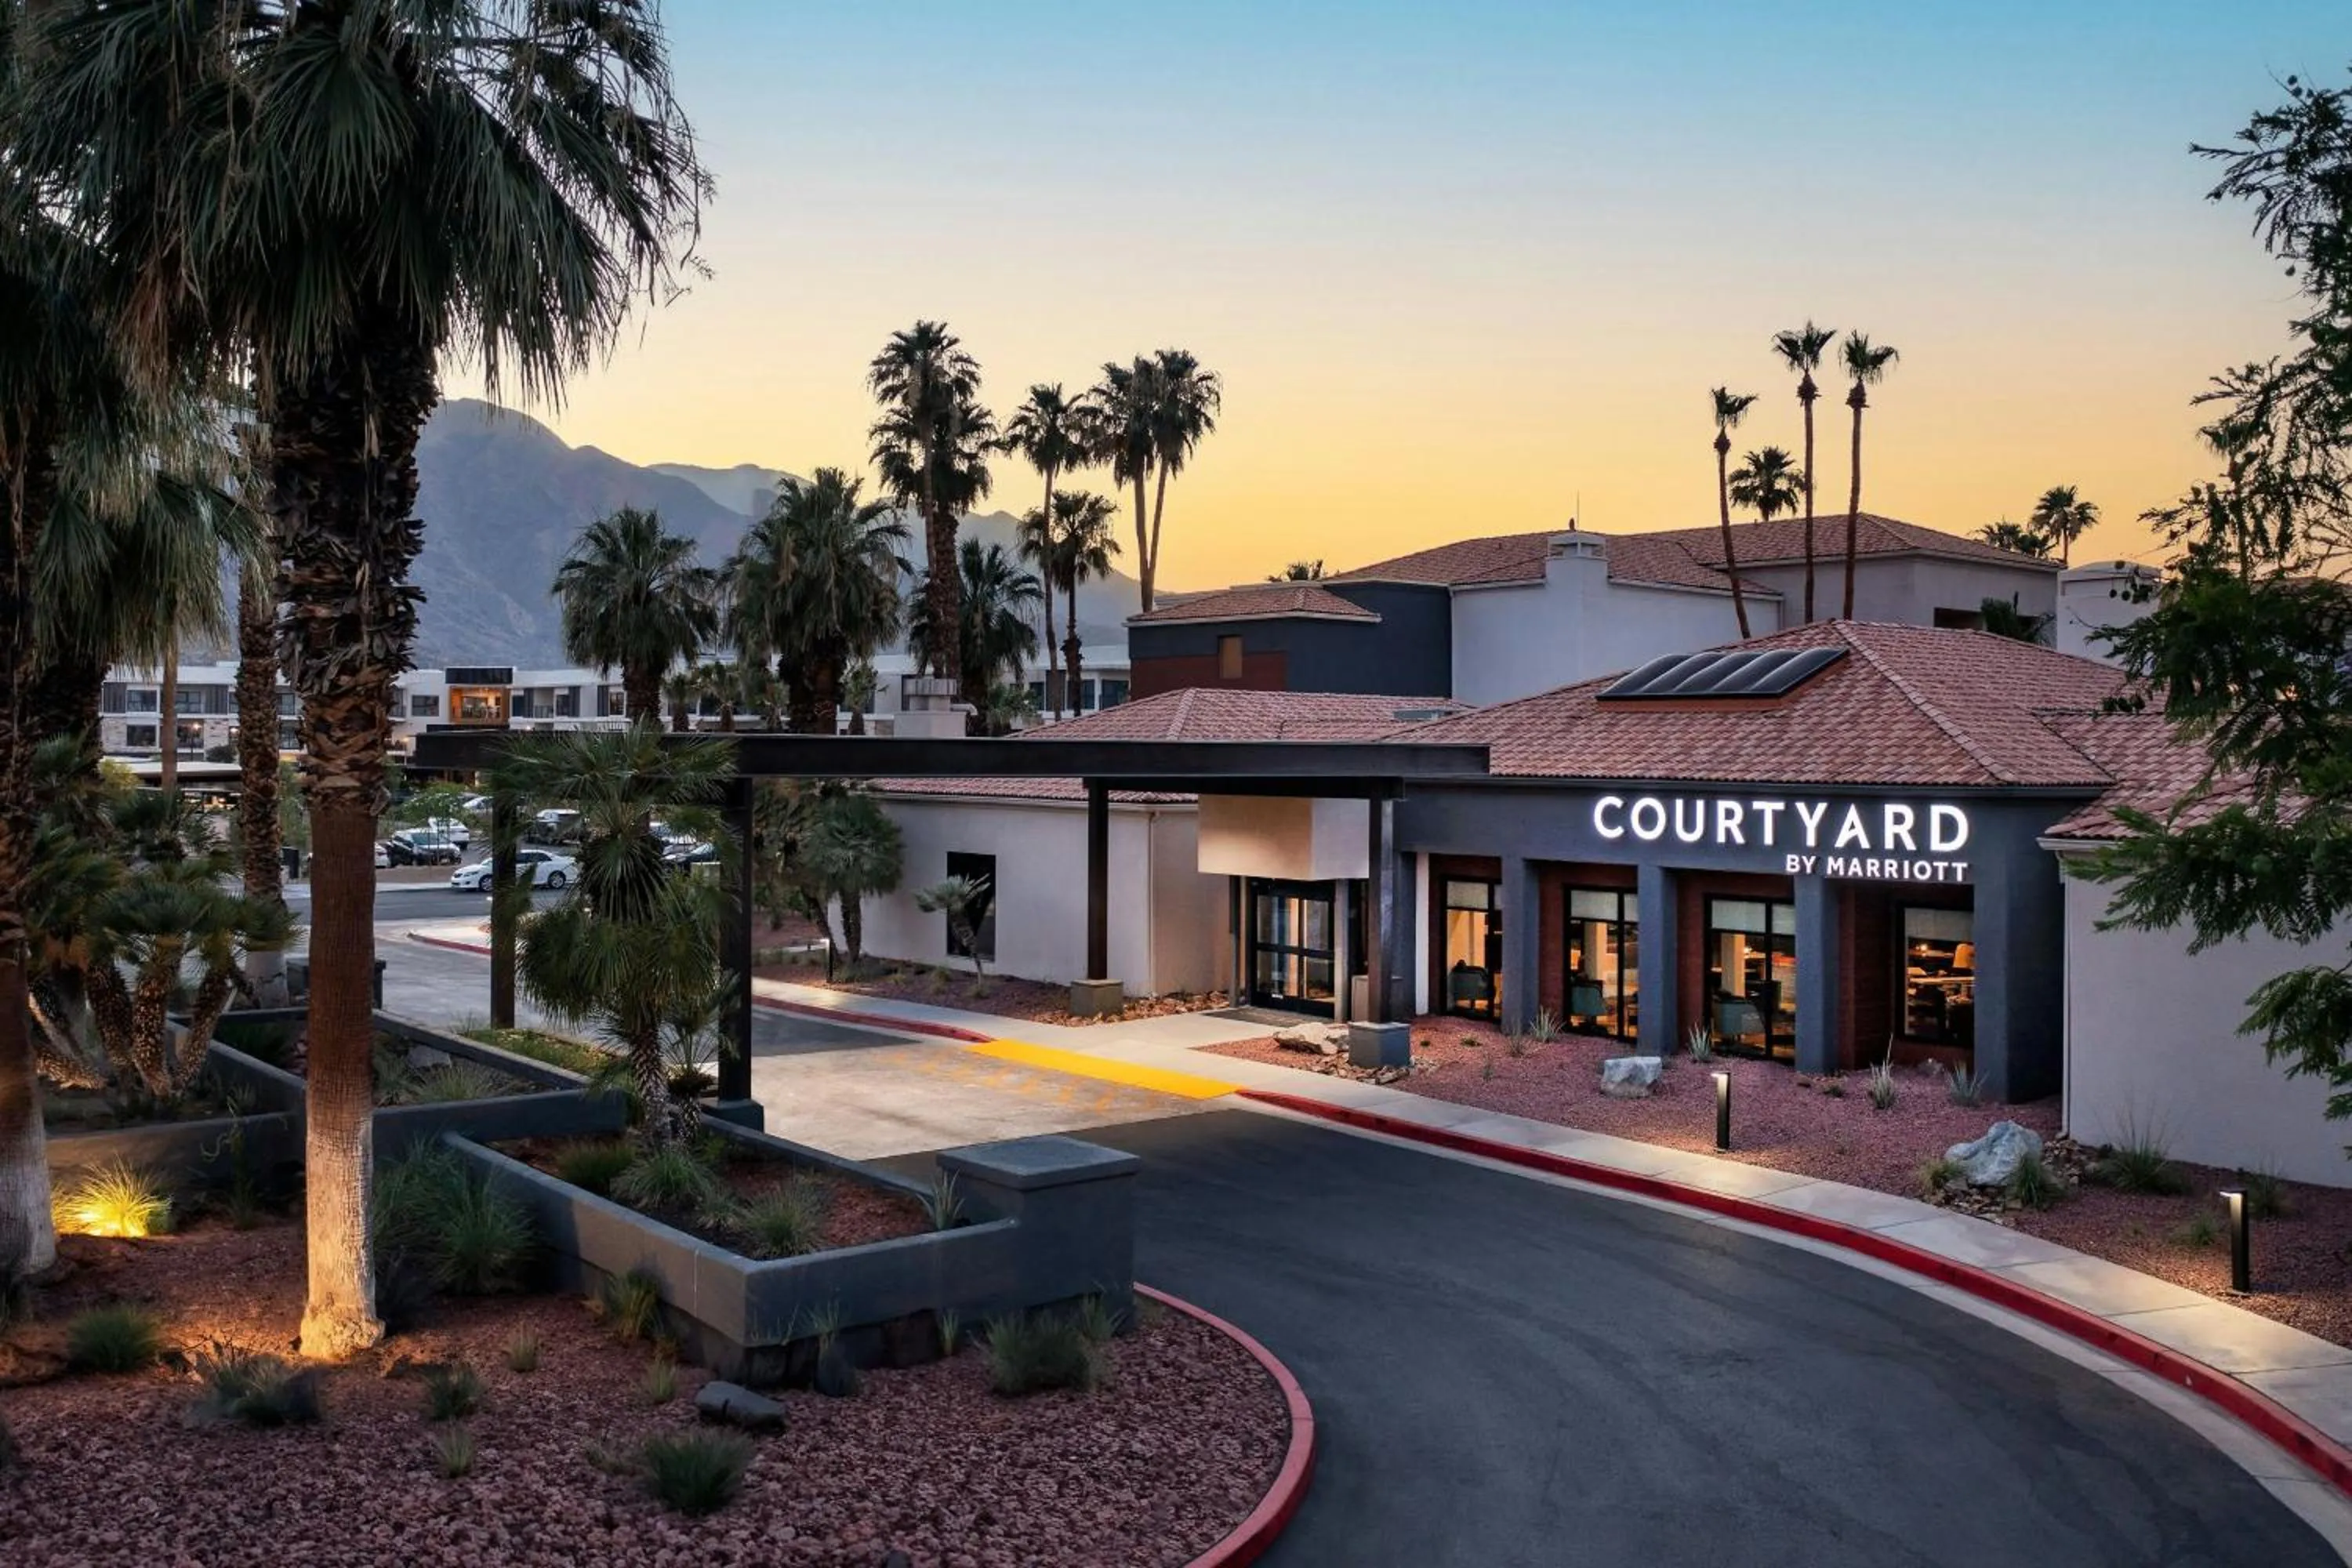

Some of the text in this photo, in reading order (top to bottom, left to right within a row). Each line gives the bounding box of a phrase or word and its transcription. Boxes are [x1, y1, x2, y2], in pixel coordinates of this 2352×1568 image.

[1593, 796, 1969, 852] COURTYARD
[1785, 854, 1968, 882] BY MARRIOTT
